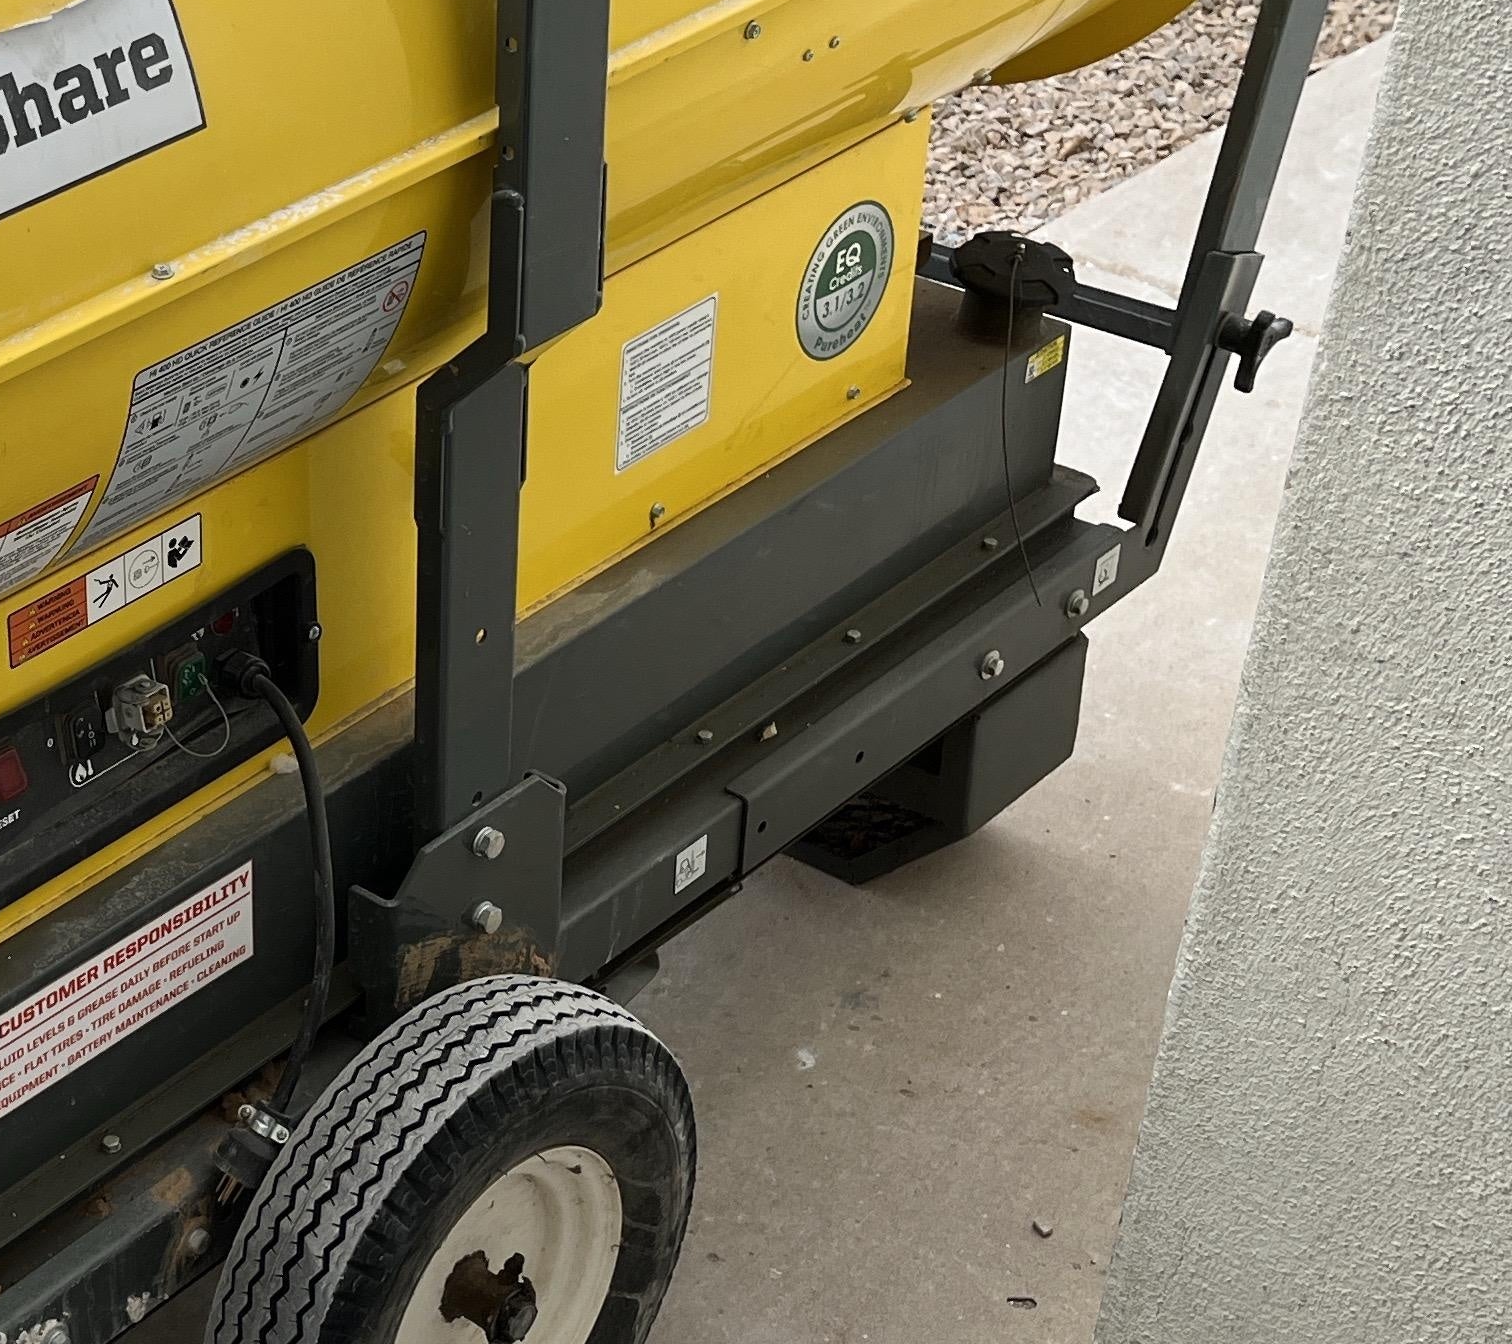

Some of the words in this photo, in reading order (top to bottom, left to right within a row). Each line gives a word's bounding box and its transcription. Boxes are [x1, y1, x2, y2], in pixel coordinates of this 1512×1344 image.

[802, 252, 824, 320] CREATING
[826, 215, 855, 248] GREEN
[829, 265, 863, 290] Credits
[836, 242, 861, 274] EQ
[103, 870, 249, 974] RESPONSIBILITY
[24, 1053, 49, 1075] FLAT
[50, 1029, 83, 1057] TIRES
[90, 1009, 116, 1031] TIRE
[118, 979, 162, 1014] DAMAGE
[169, 940, 225, 982] REFUELING
[27, 1023, 65, 1053] LEVELS
[78, 988, 118, 1020] GREASE
[120, 967, 150, 993] DAILY
[153, 941, 191, 973] BEFORE
[194, 920, 225, 947] START
[227, 910, 241, 927] UP
[67, 1030, 113, 1066] BATTERY
[115, 982, 189, 1035] MAINTENANCE
[196, 944, 246, 982] CLEANING
